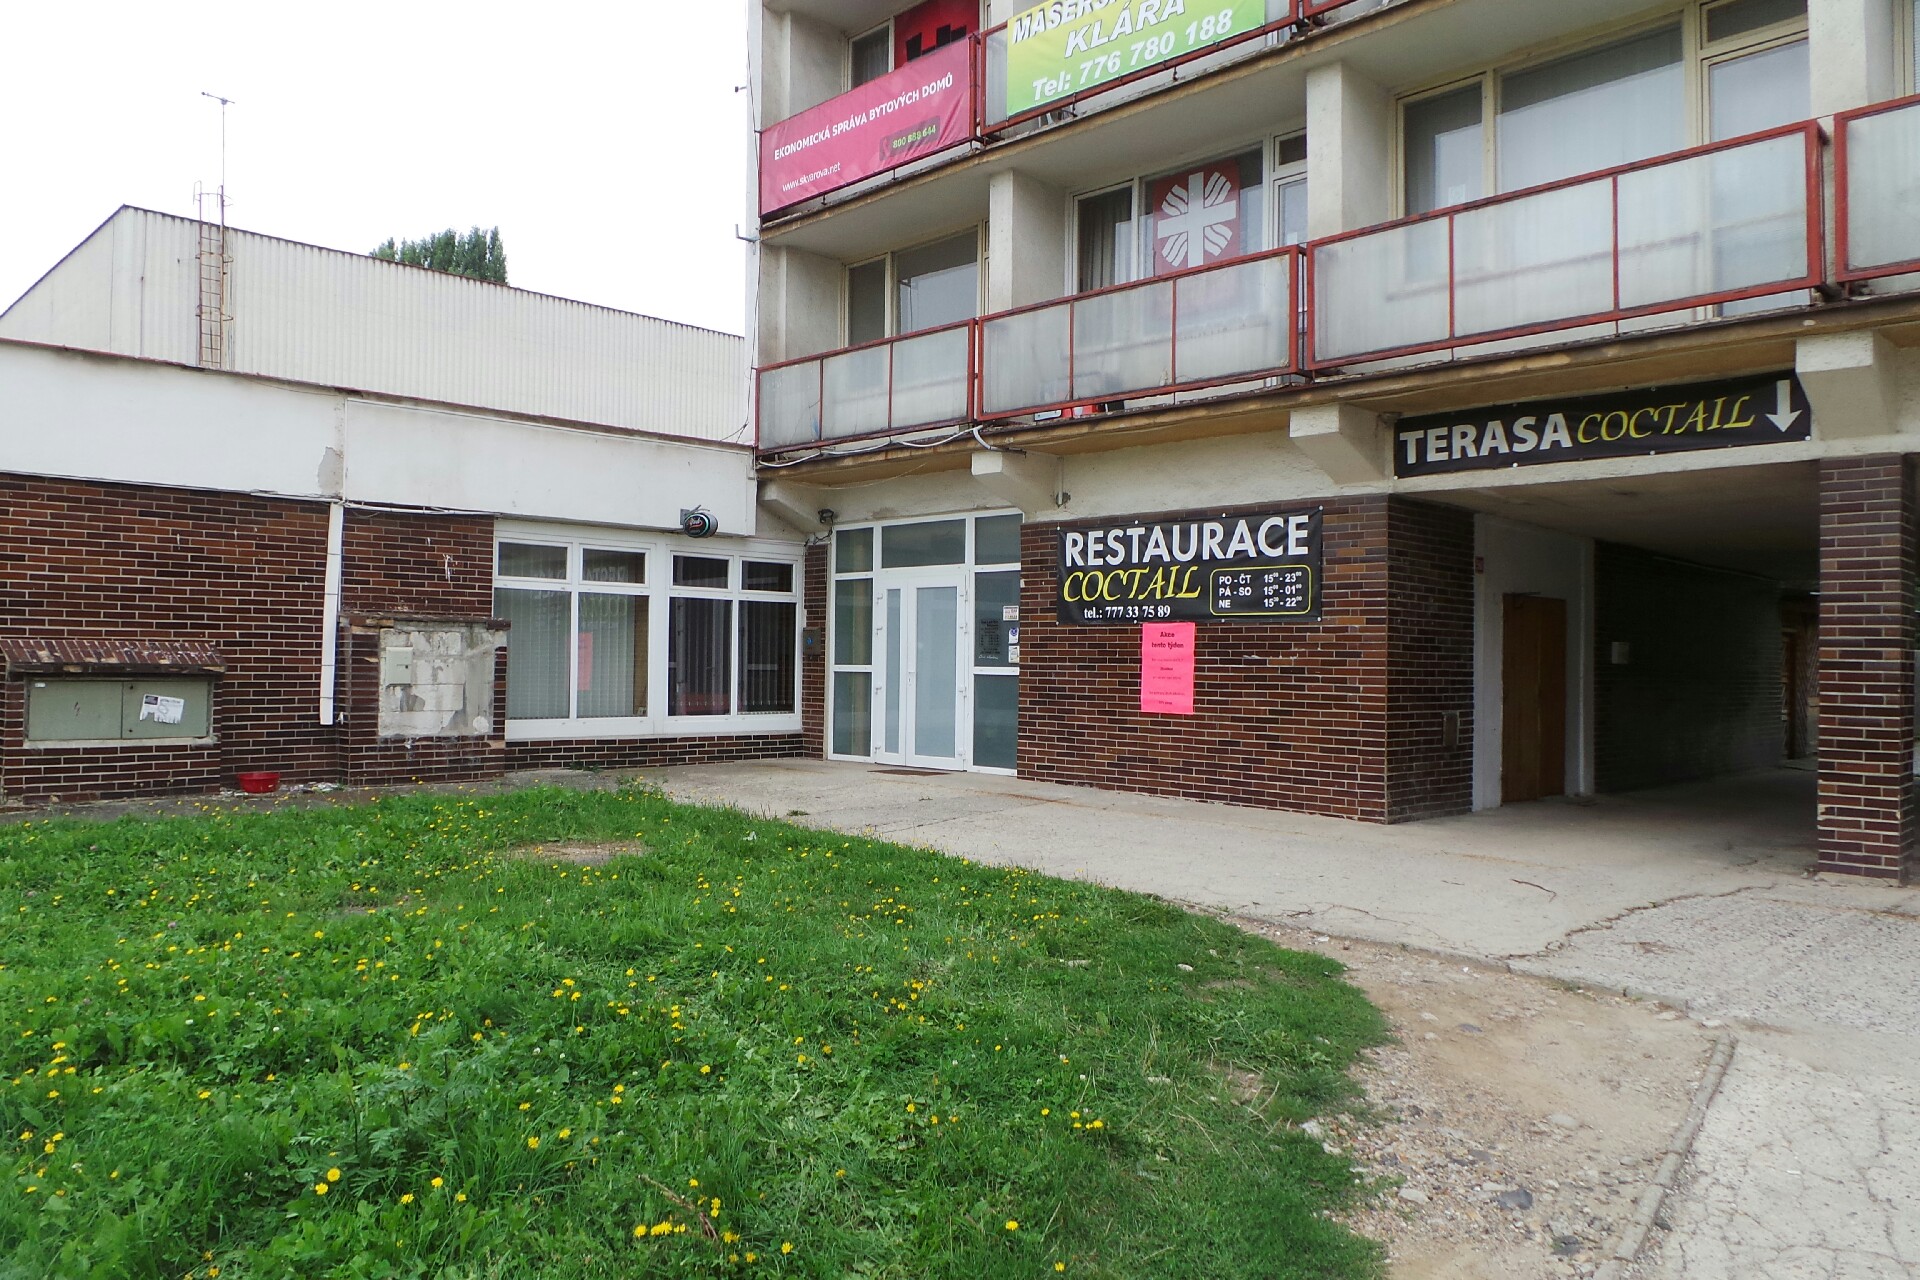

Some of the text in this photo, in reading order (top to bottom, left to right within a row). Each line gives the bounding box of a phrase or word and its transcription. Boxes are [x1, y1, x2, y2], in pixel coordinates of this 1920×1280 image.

[1064, 0, 1186, 58] KLÁRA
[1032, 8, 1233, 101] Tel: 776 780 188
[774, 71, 953, 160] EKONOMICKÁ SPRÁVA BYTOVÝCH DOMŮ
[892, 136, 906, 149] 800
[922, 124, 936, 137] 644
[782, 161, 841, 192] www.skvarova.net
[1399, 395, 1756, 465] TERASA COCTAIL
[1065, 515, 1309, 567] RESTAURACE
[1063, 565, 1202, 602] COCTAIL
[1218, 576, 1232, 585] PO
[1239, 573, 1252, 584] ČT
[1218, 586, 1232, 597] PÁ
[1238, 587, 1252, 596] SO
[1084, 604, 1171, 619] tel.: 777 33 75 89
[1218, 599, 1231, 608] NE
